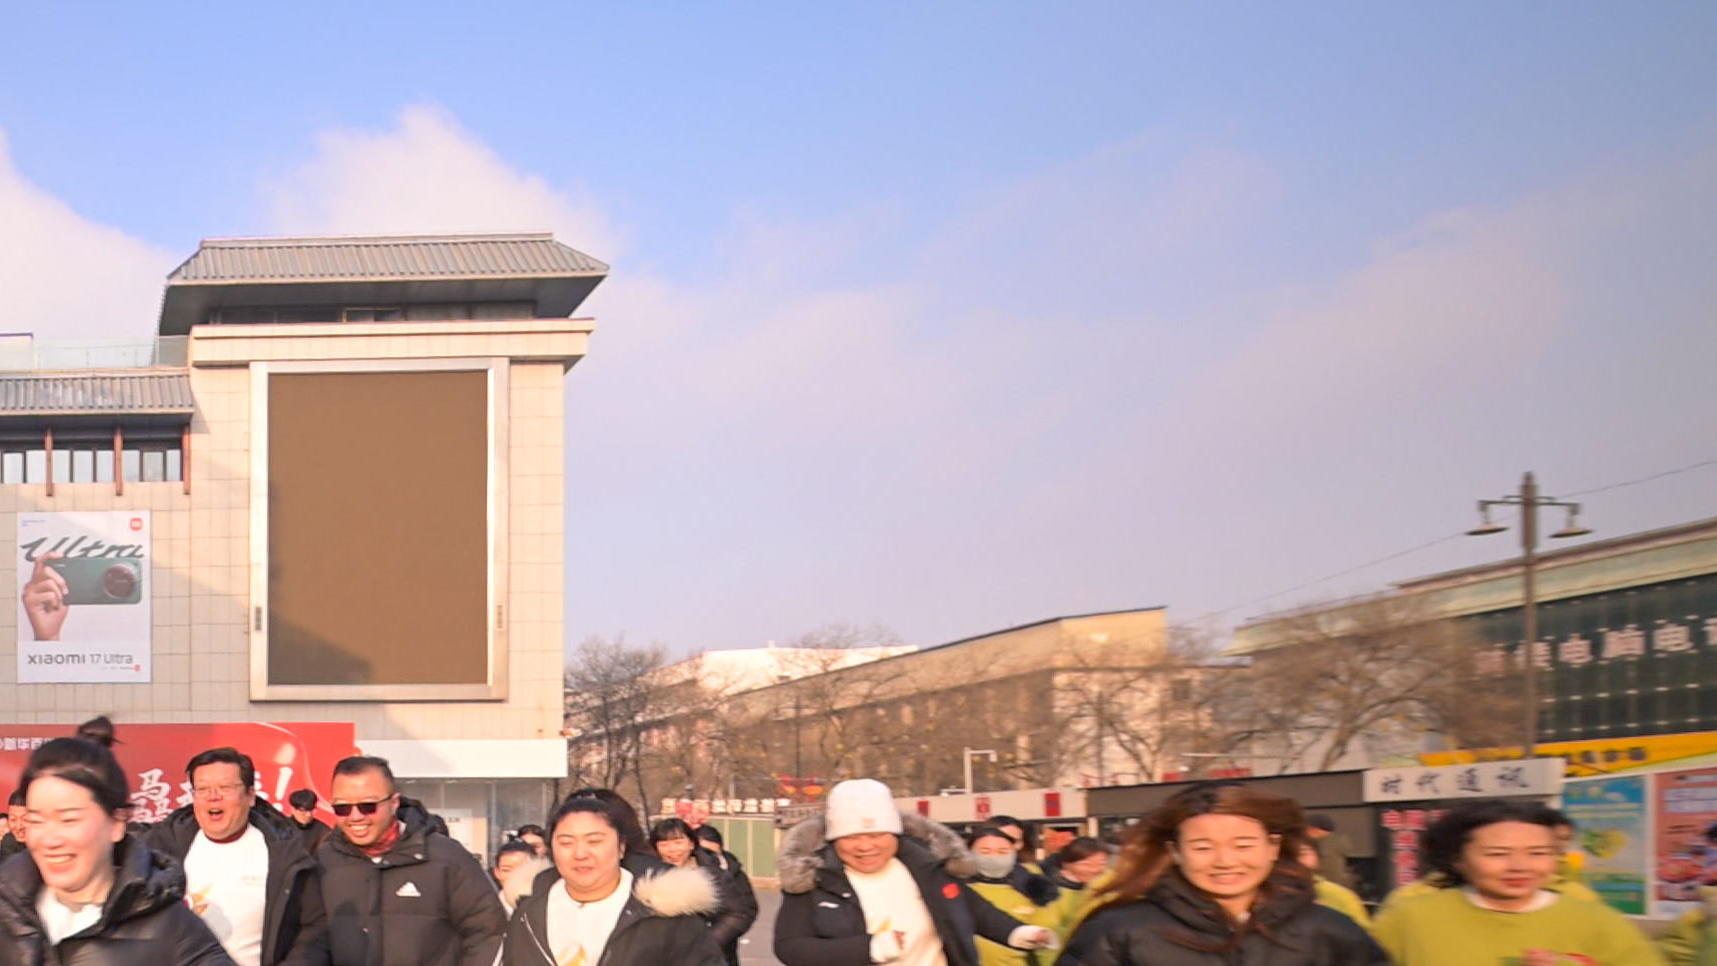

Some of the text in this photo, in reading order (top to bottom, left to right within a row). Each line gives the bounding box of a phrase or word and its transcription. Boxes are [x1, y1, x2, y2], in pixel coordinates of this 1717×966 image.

[90, 653, 101, 665] 17
[104, 653, 133, 665] Ultra
[3, 737, 55, 751] 新华百
